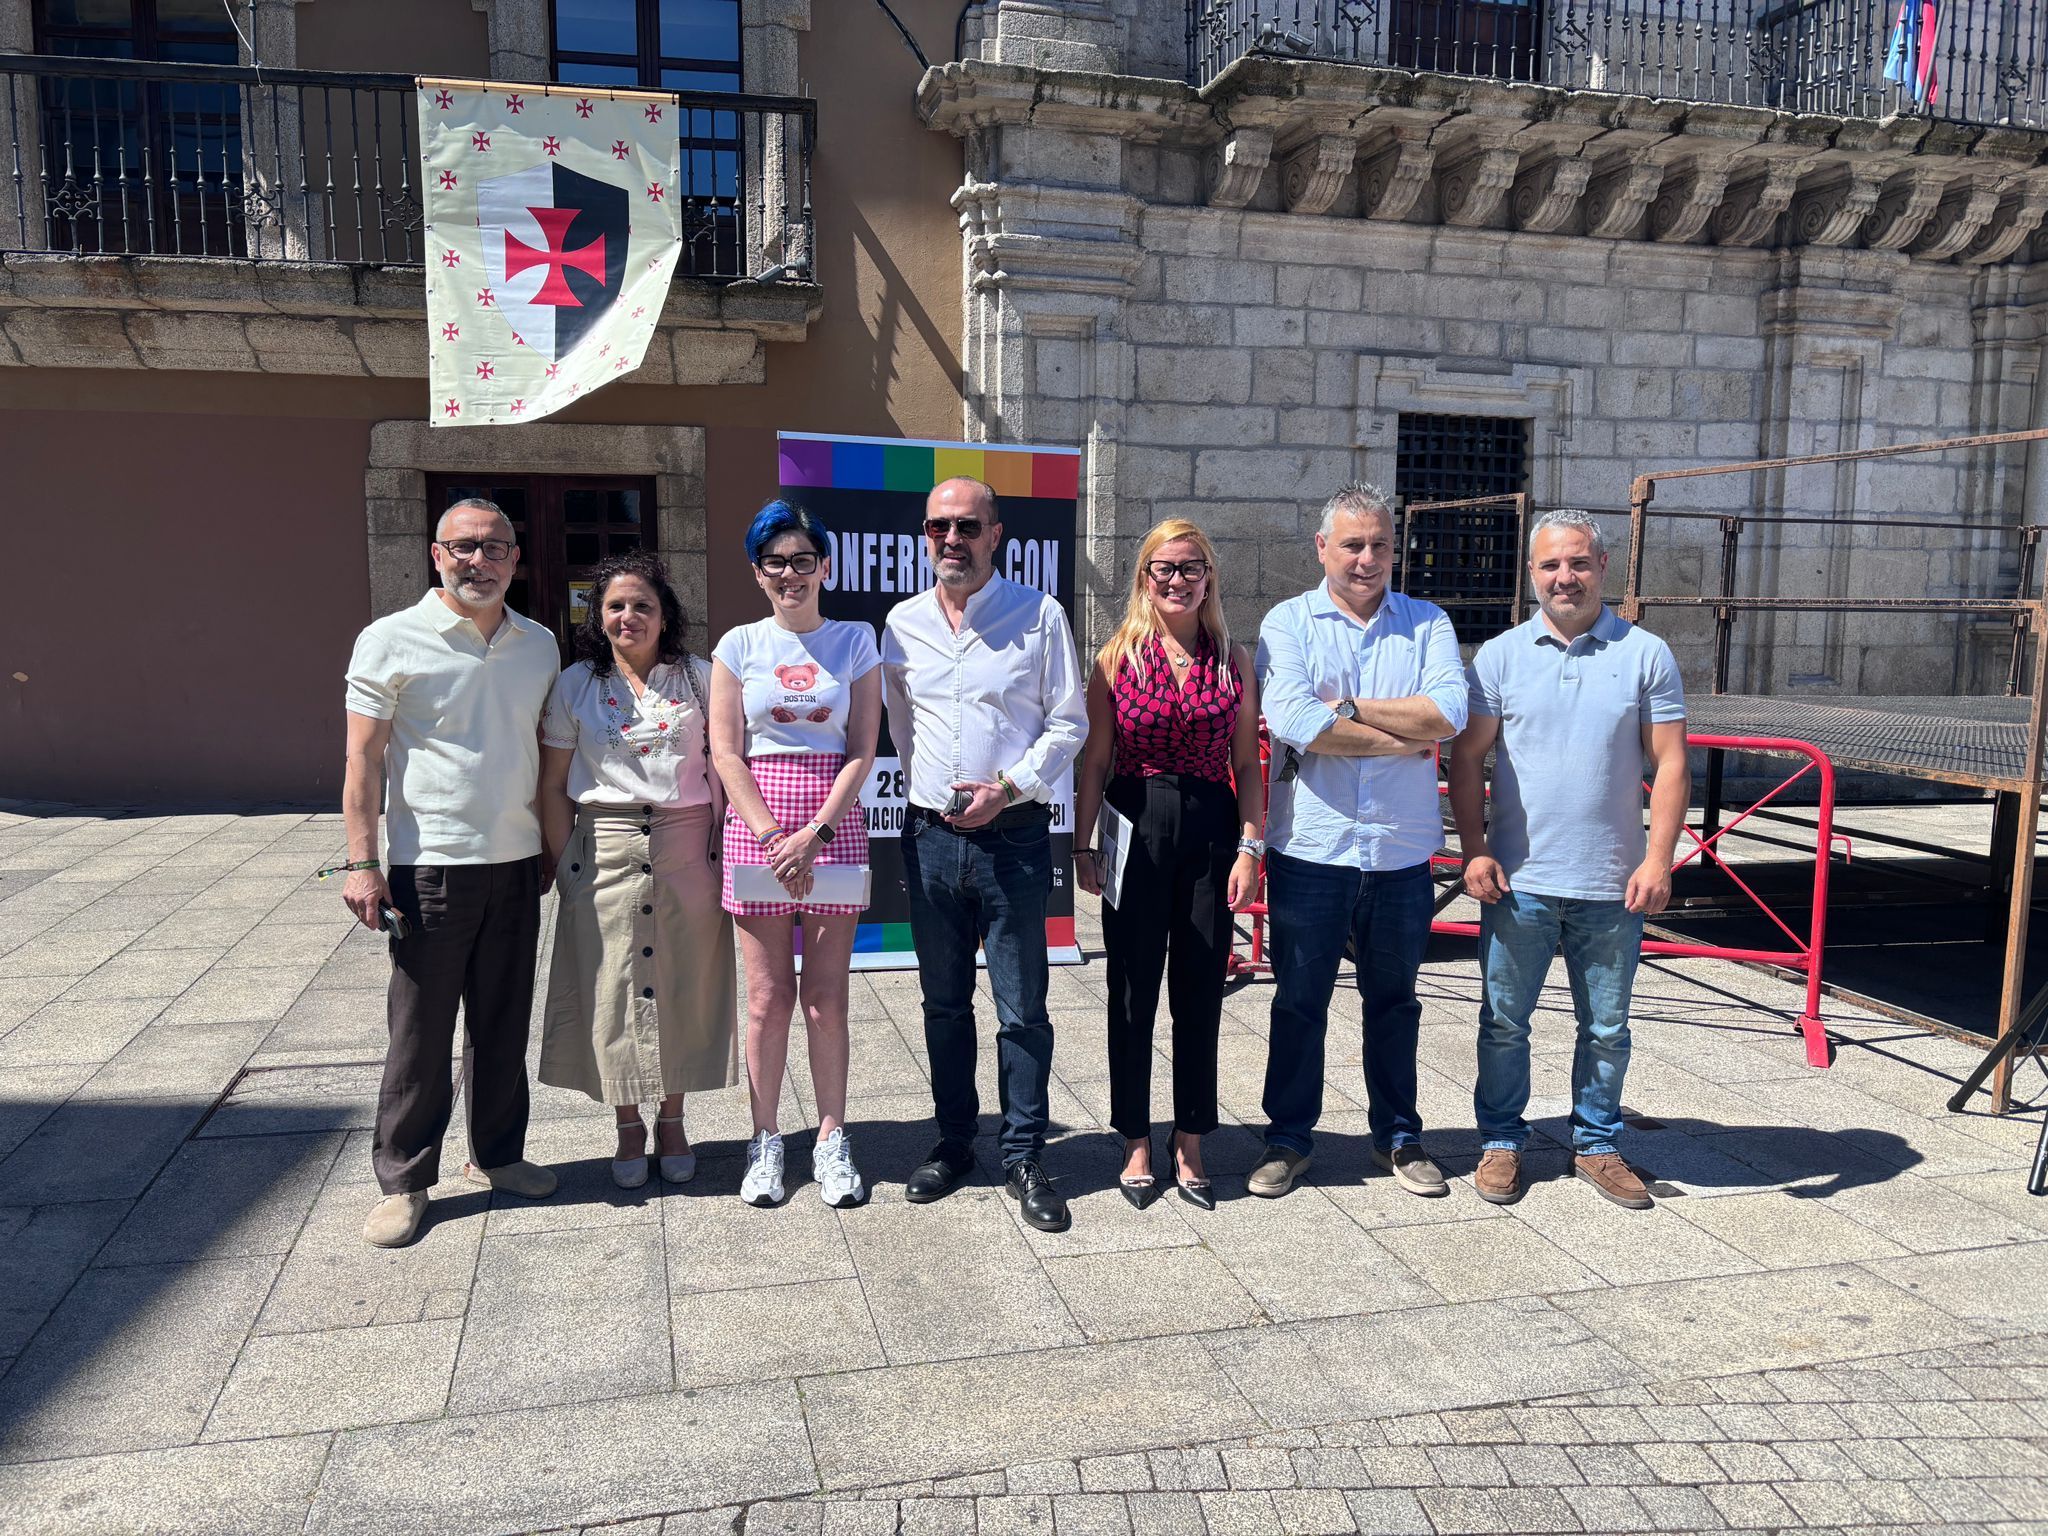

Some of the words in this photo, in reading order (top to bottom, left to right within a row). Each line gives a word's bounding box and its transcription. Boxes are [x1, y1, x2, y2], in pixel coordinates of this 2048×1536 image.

[1006, 538, 1060, 597] CON
[783, 694, 817, 703] BOSTON
[876, 770, 904, 798] 28
[863, 806, 907, 831] NACIO
[1048, 803, 1065, 826] BI
